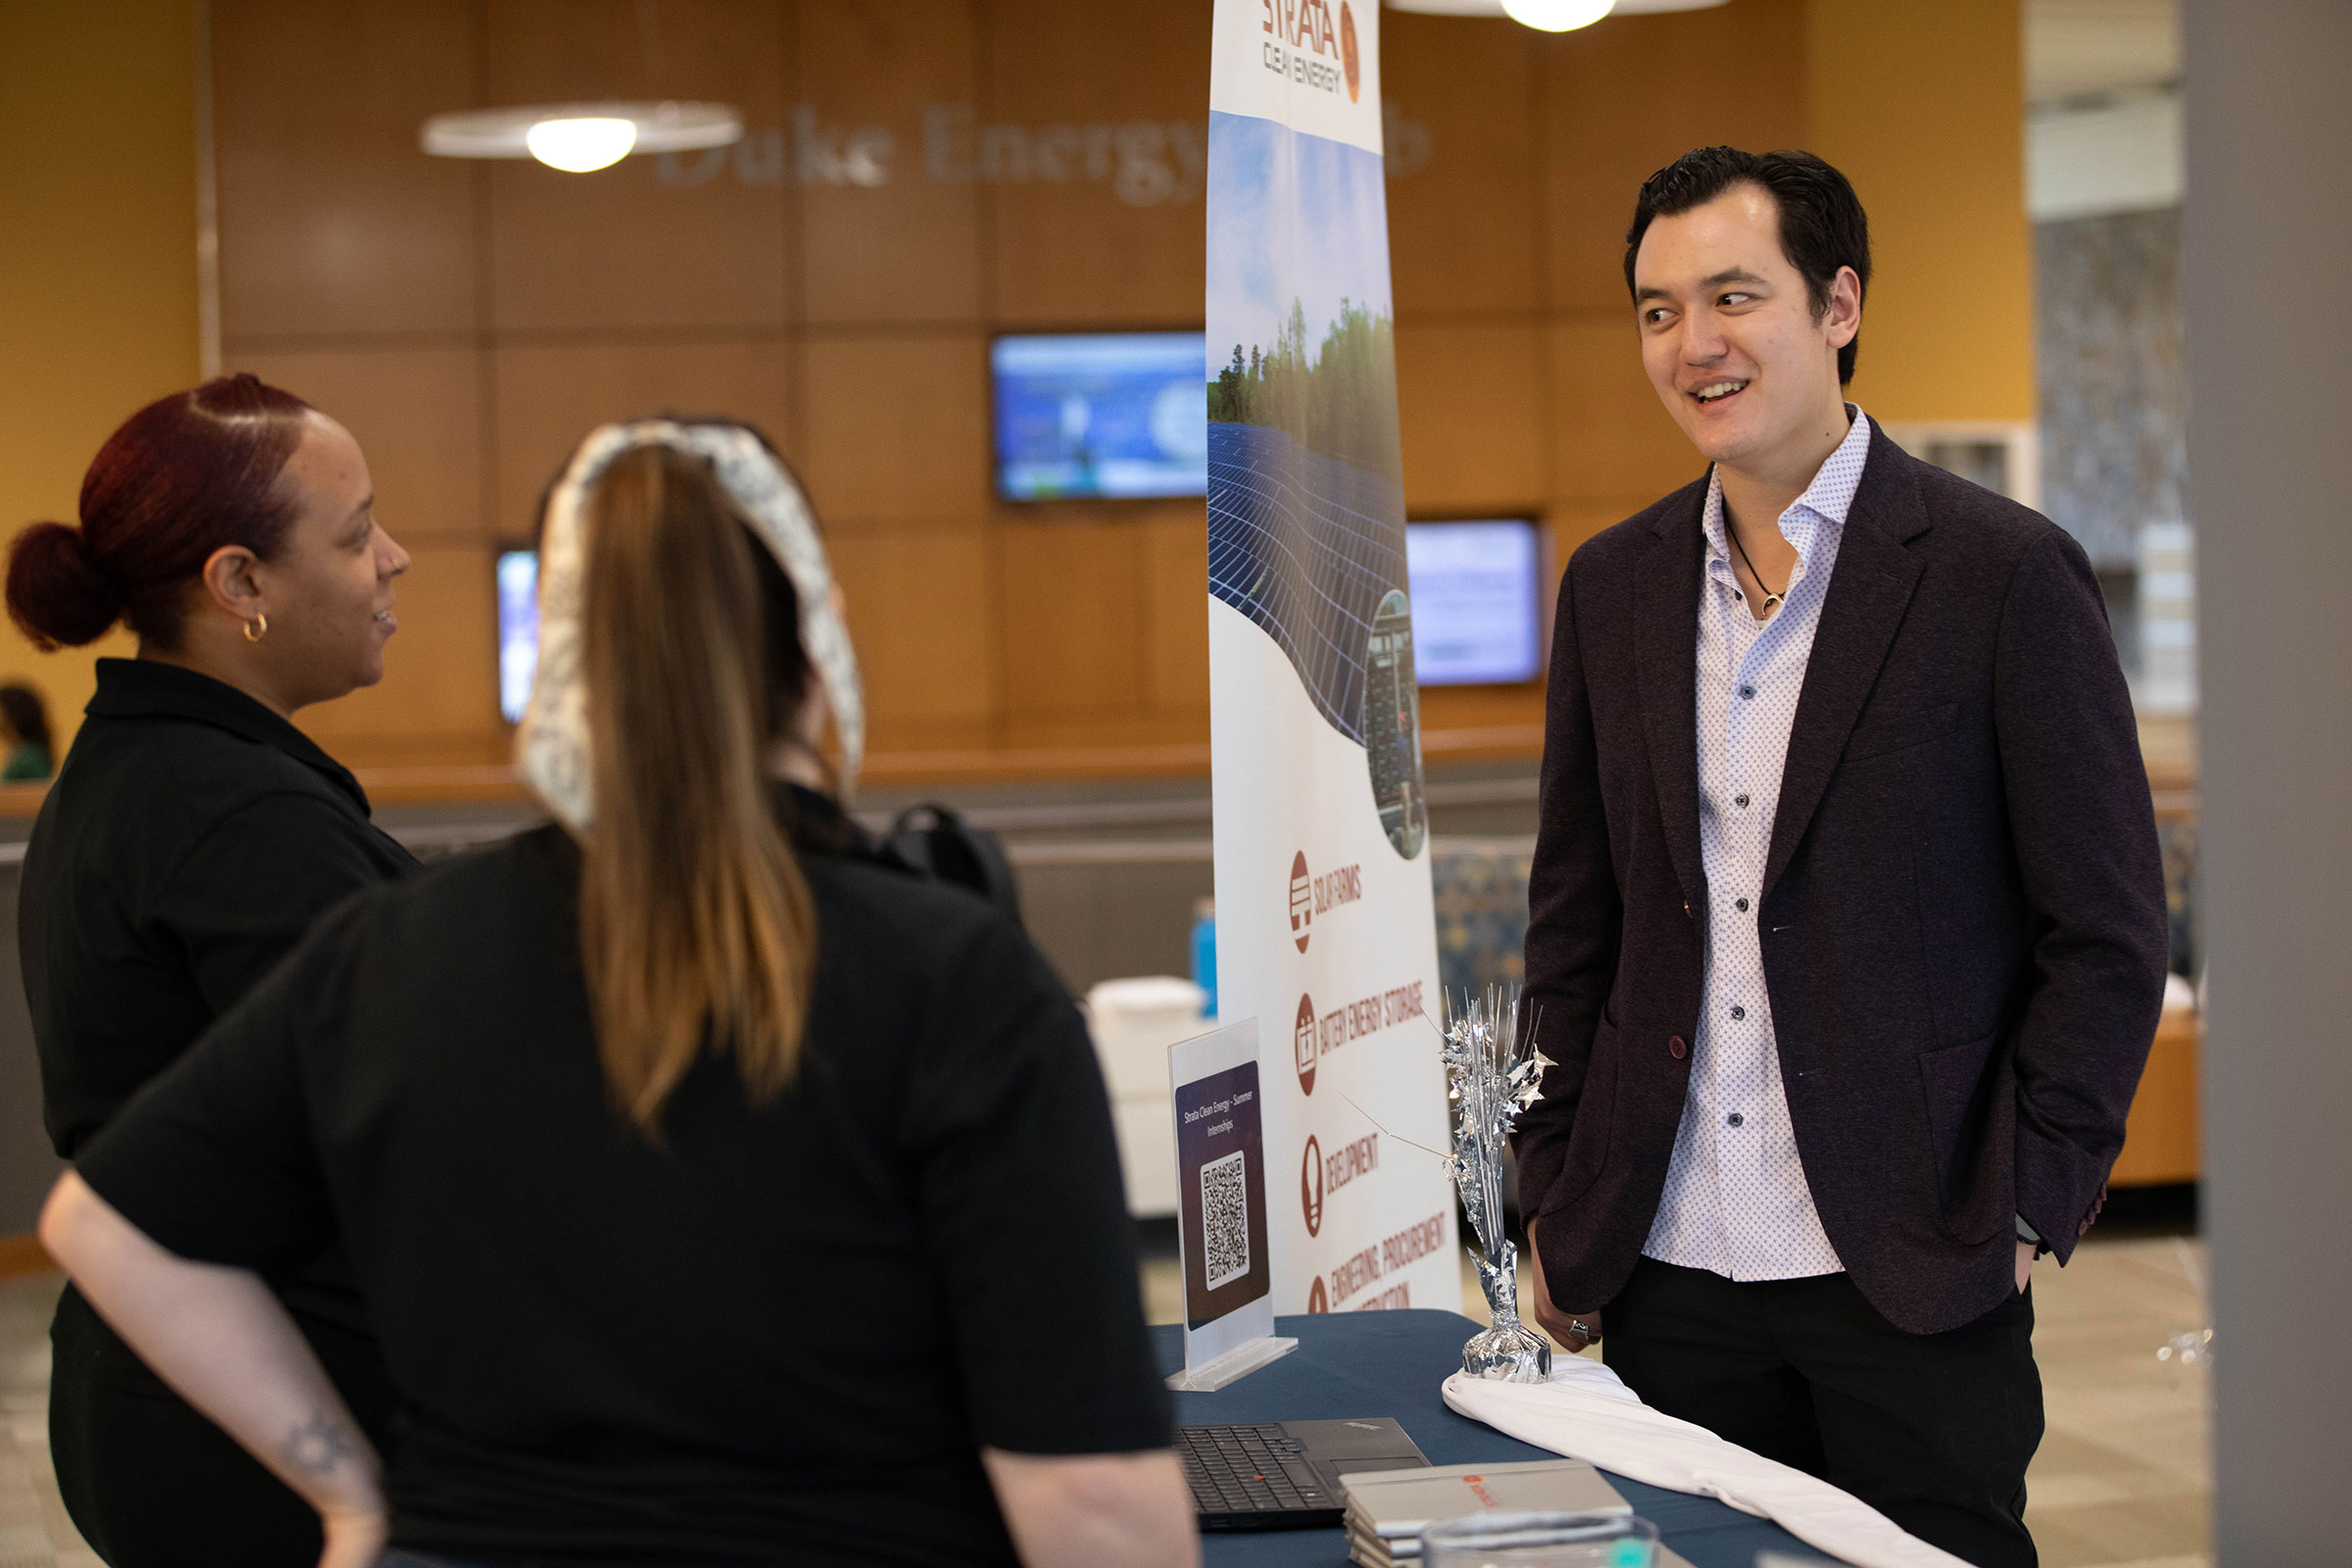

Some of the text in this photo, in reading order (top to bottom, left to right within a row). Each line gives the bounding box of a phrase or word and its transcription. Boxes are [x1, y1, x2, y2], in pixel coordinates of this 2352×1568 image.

[1262, 0, 1339, 60] STRATA
[1263, 41, 1341, 94] CLEAN ENERGY
[654, 102, 1207, 208] Duke Energy
[1314, 863, 1362, 916] SOLAR FARMS
[1319, 979, 1424, 1055] BATTERY ENERGY STORAGE
[1184, 1109, 1200, 1124] Strata
[1200, 1104, 1213, 1118] Clean
[1213, 1100, 1230, 1113] Energy
[1233, 1090, 1253, 1106] Summer
[1207, 1118, 1234, 1137] Internships
[1325, 1132, 1380, 1196] DEVELOPMENT
[1383, 1210, 1445, 1275] PROCUREMENT
